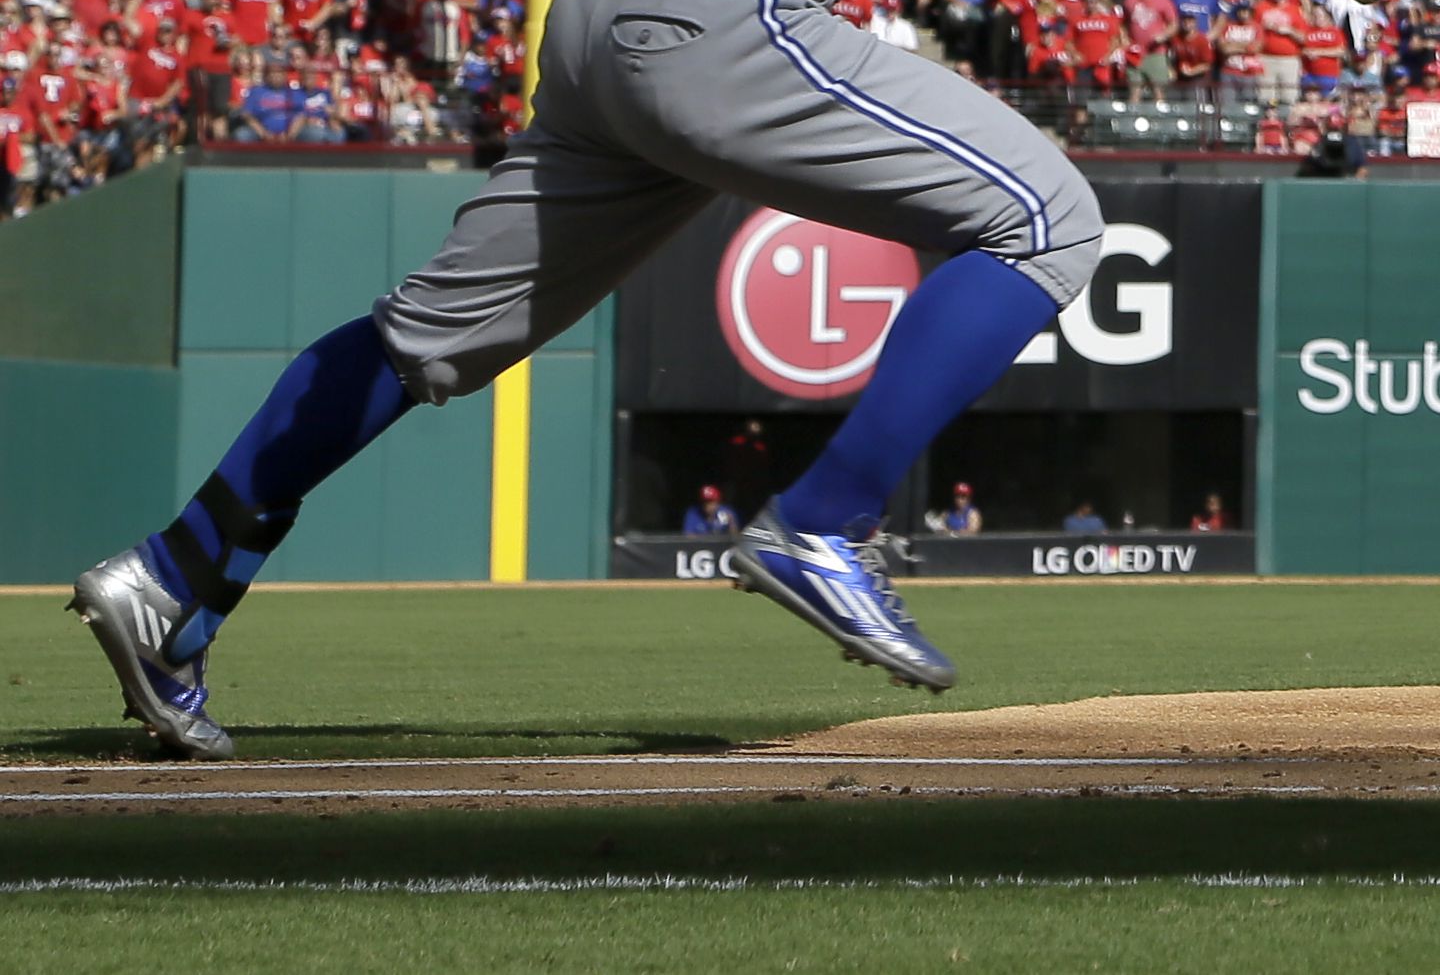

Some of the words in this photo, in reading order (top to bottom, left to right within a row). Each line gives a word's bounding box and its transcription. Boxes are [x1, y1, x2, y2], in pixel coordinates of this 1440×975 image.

[1014, 223, 1173, 366] G
[676, 550, 716, 578] LG
[1032, 546, 1070, 575] LG
[1073, 544, 1155, 574] OLED
[1156, 544, 1197, 572] TV
